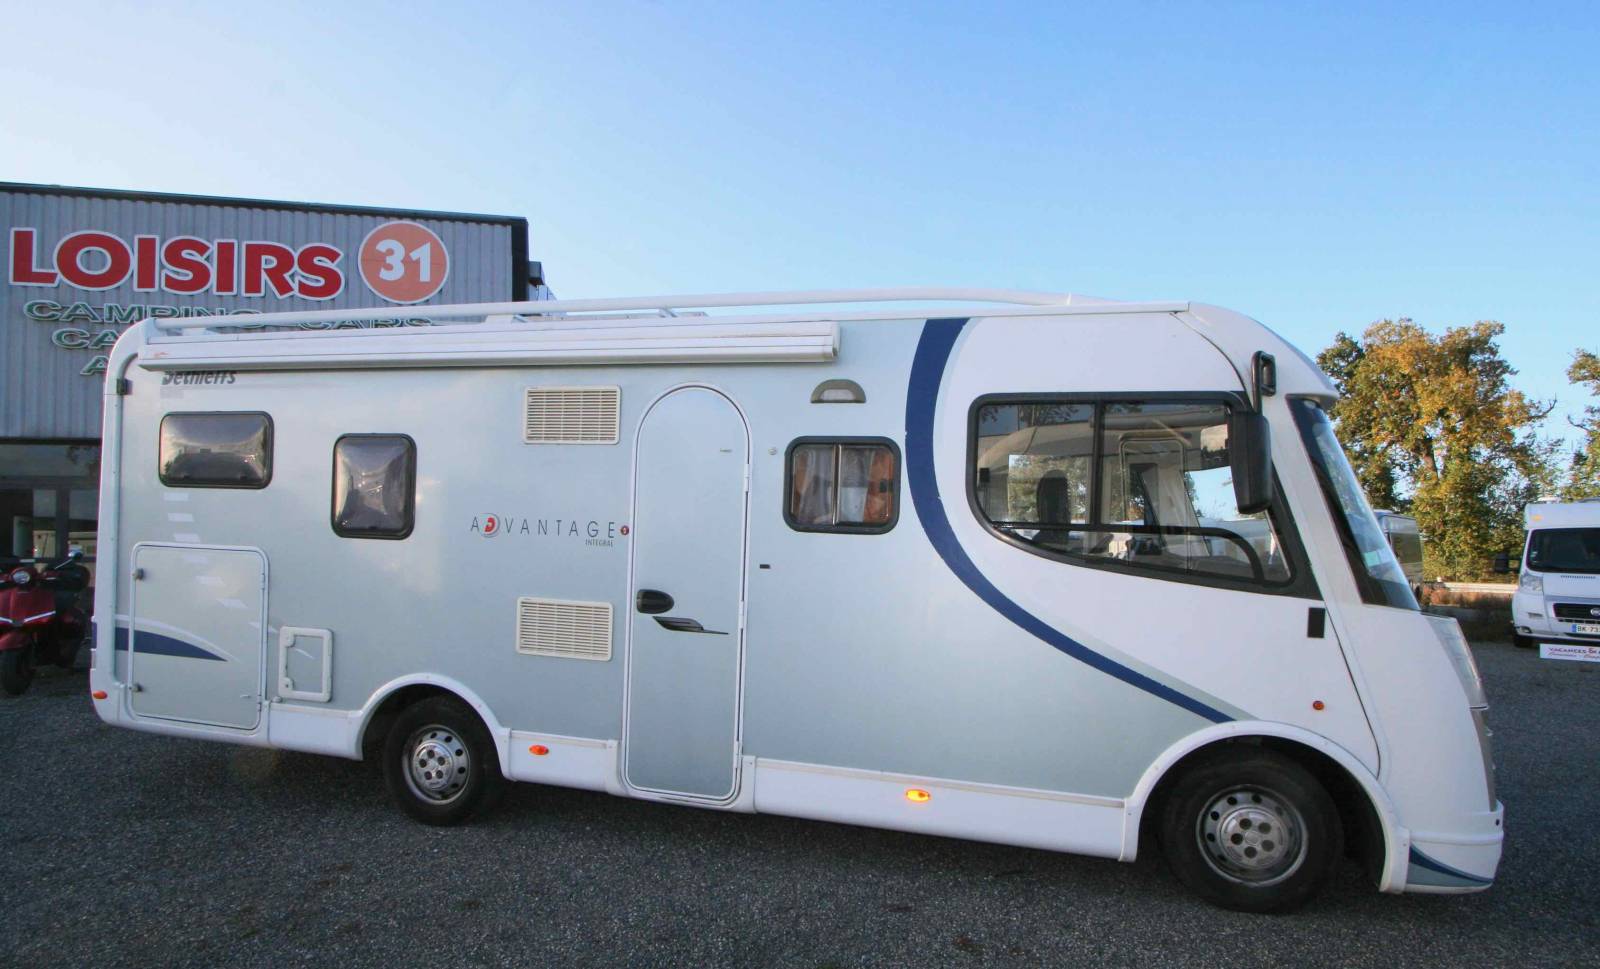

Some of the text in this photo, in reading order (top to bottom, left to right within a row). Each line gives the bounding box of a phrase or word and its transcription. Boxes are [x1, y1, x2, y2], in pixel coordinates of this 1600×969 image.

[9, 227, 431, 300] LOISIRS 31
[470, 512, 616, 539] ADVANTAGE
